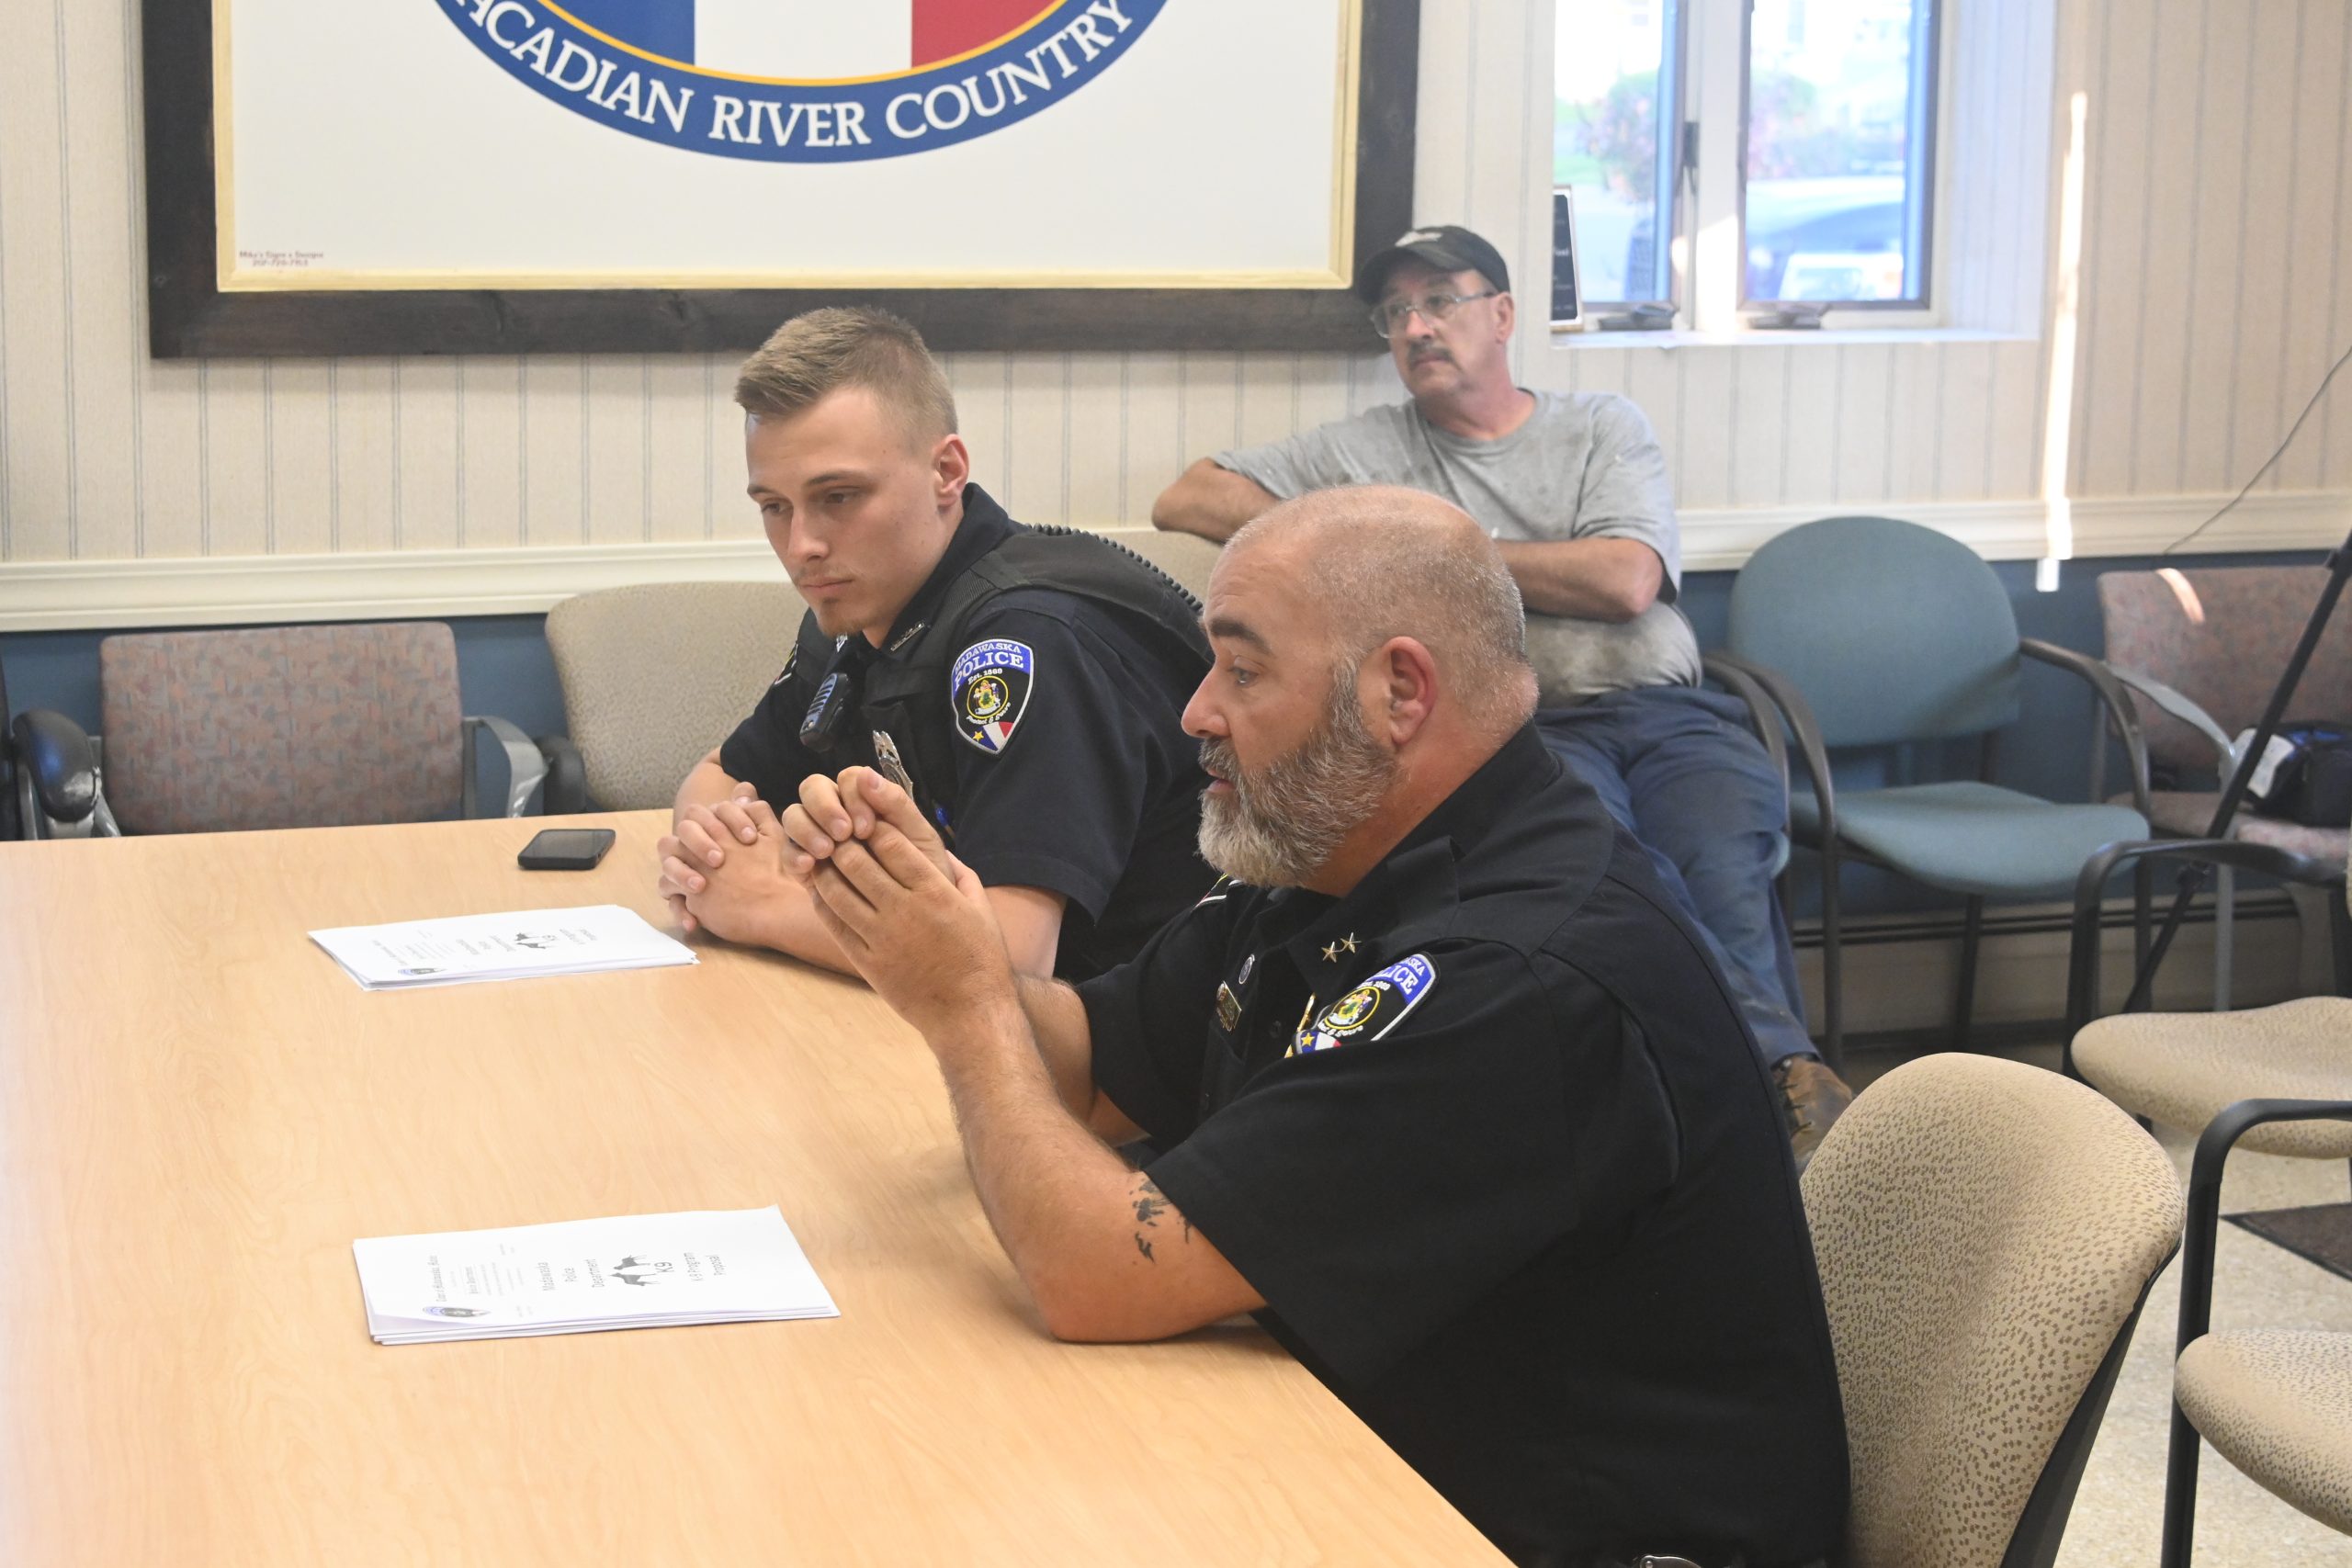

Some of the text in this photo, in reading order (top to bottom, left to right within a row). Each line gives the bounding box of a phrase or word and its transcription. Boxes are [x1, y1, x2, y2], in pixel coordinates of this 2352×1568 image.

[707, 94, 872, 147] RIVER
[885, 0, 1133, 140] COUNTRY
[955, 651, 1024, 692] POLICE
[653, 1261, 674, 1273] K9
